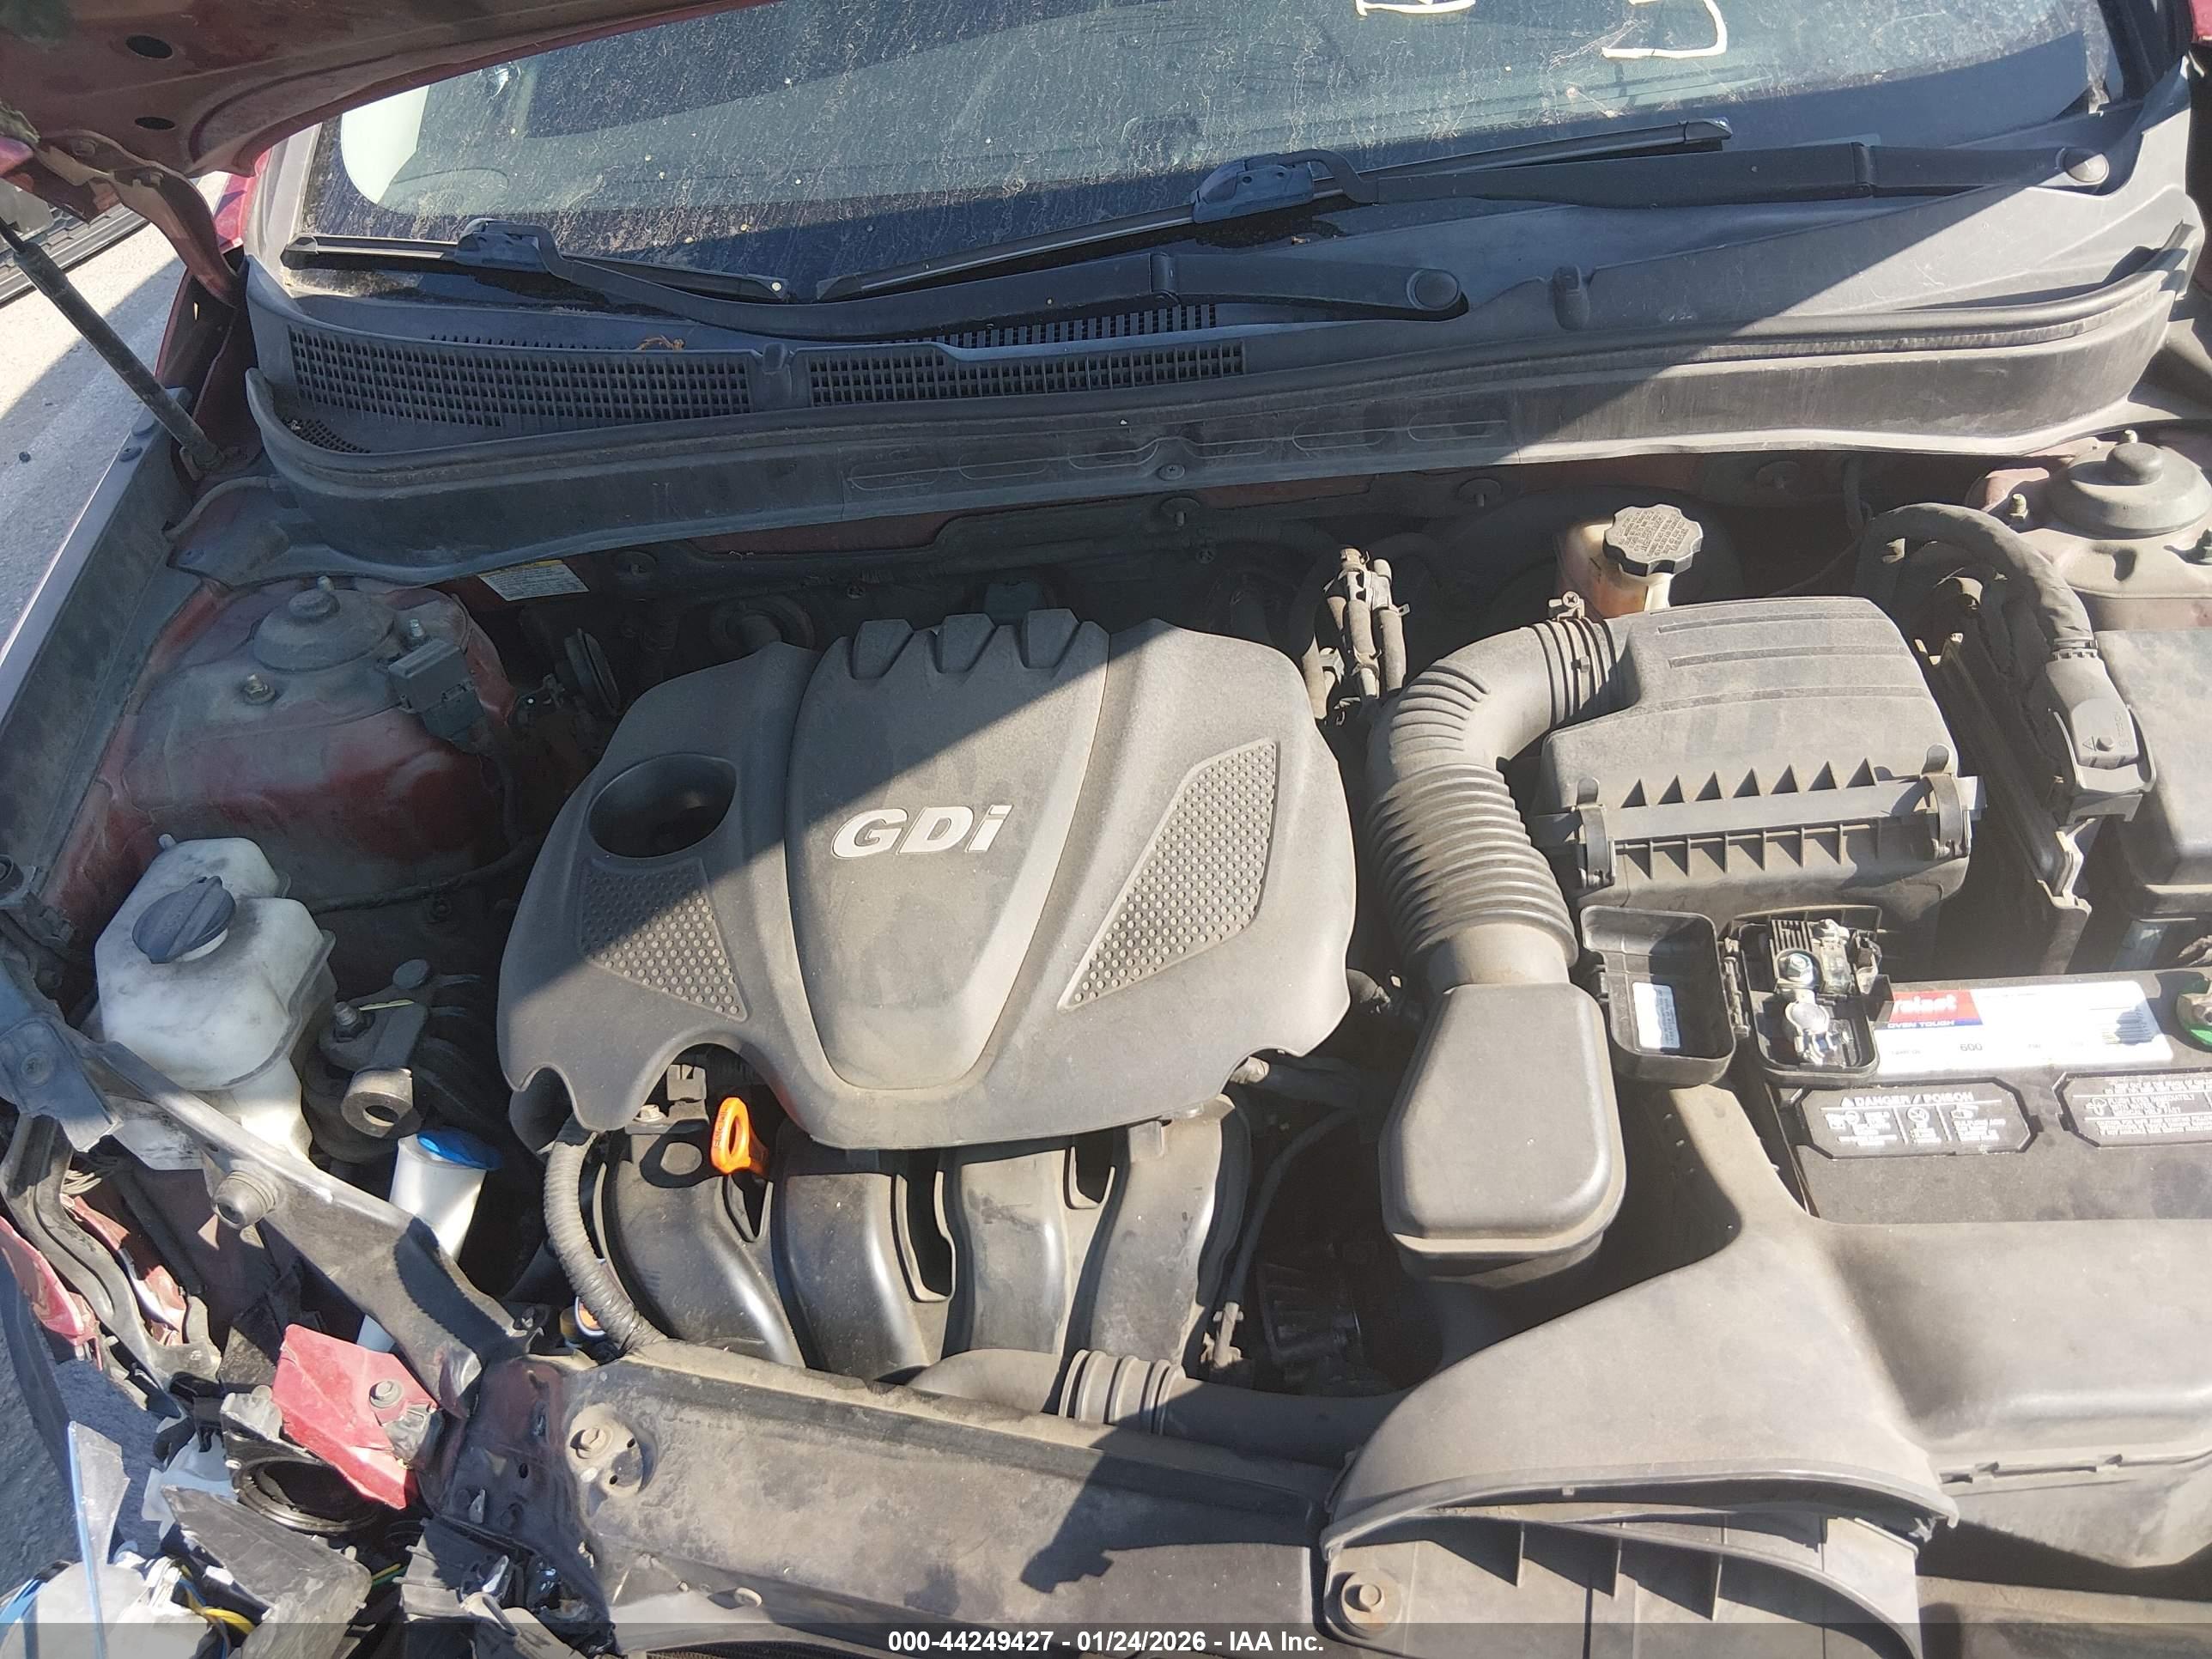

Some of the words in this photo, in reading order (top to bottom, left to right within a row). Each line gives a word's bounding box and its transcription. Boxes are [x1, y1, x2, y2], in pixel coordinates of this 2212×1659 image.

[831, 805, 1014, 859] GDi
[1894, 994, 1958, 1013] ralast
[1887, 1021, 1917, 1030] OVEN
[1960, 1042, 1983, 1052] 600
[1853, 1094, 1911, 1107] DANGER
[1923, 1091, 1974, 1103] POISON
